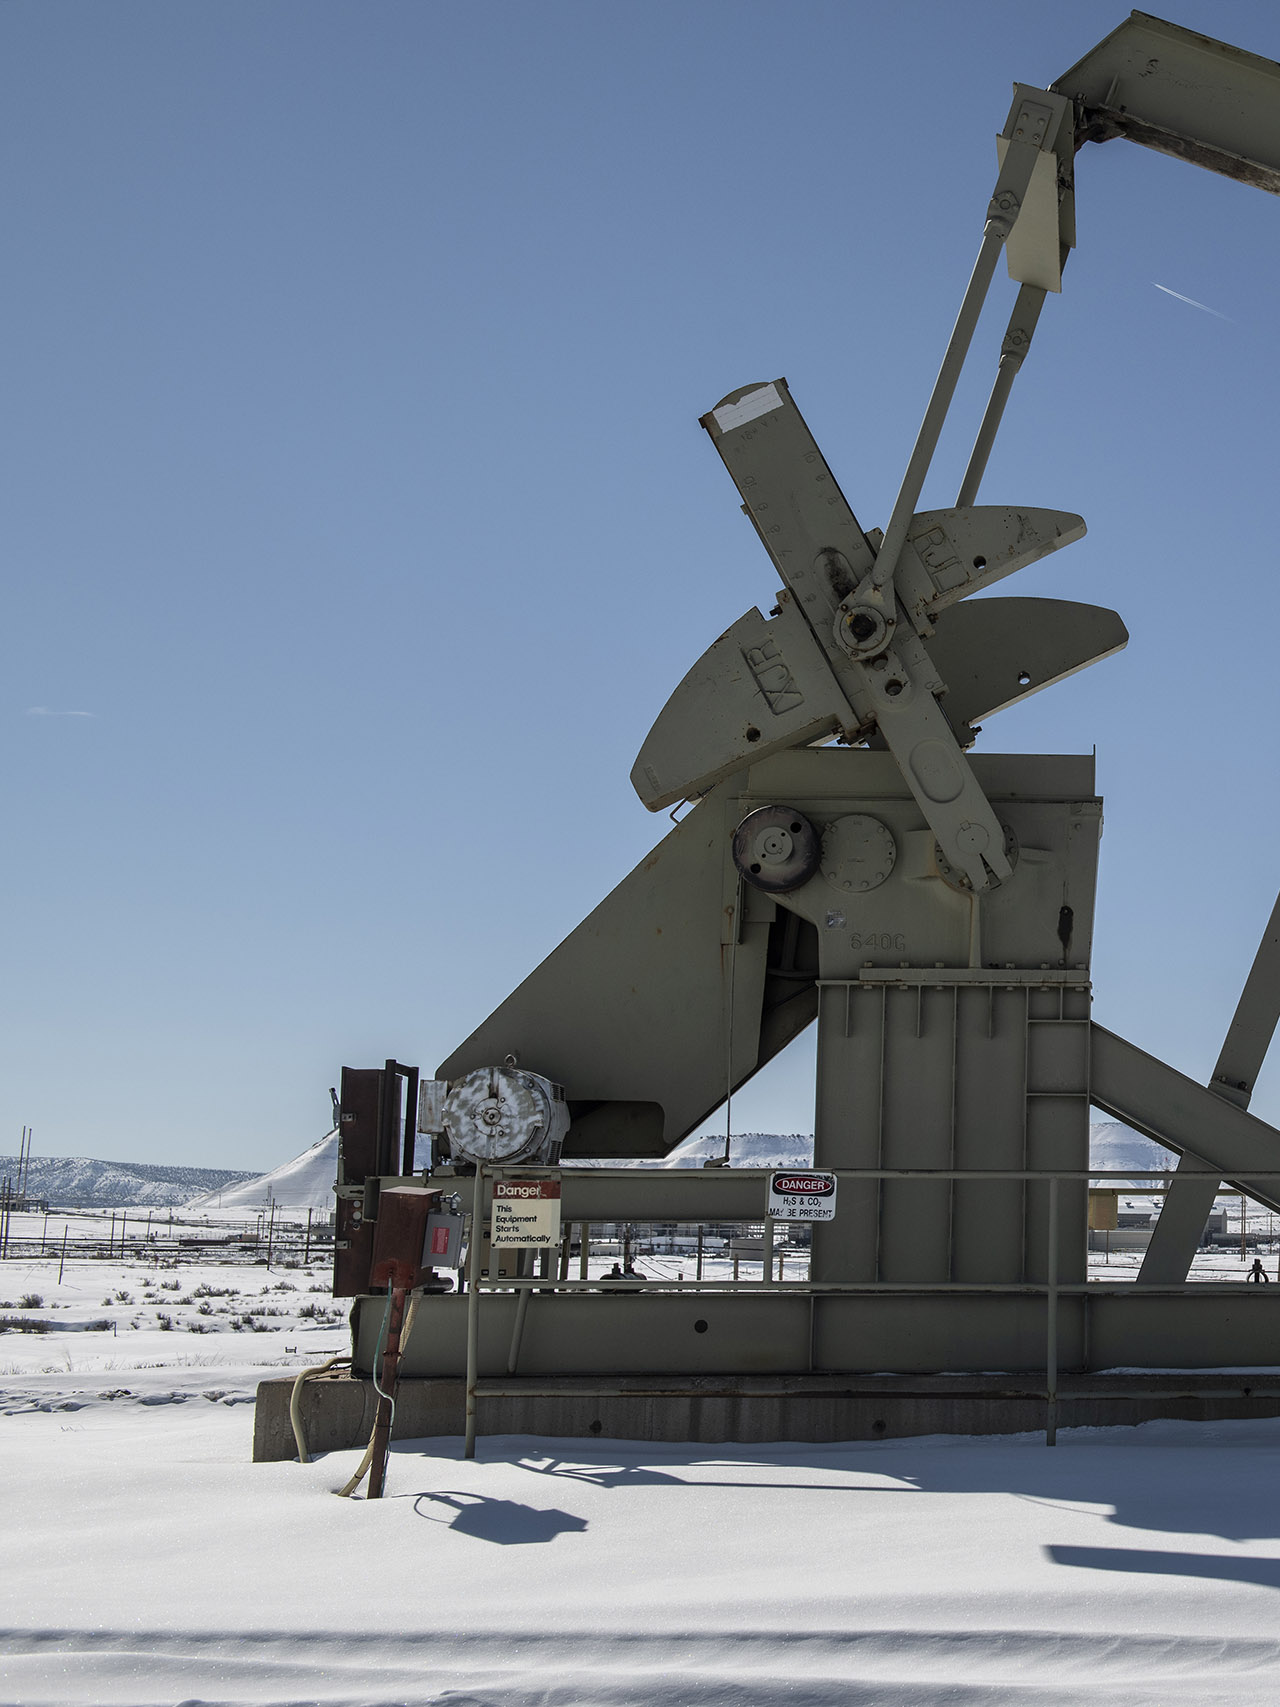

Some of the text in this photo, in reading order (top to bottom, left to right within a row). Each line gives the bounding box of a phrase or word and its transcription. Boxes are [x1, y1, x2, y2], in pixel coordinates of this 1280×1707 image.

[782, 1180, 825, 1190] DANGER
[497, 1184, 541, 1198] Danger
[799, 1197, 805, 1205] &
[497, 1205, 512, 1213] This
[799, 1209, 833, 1218] PRESENT
[496, 1215, 537, 1223] Equipment
[496, 1225, 520, 1233] Starts
[496, 1235, 551, 1243] Automatically
